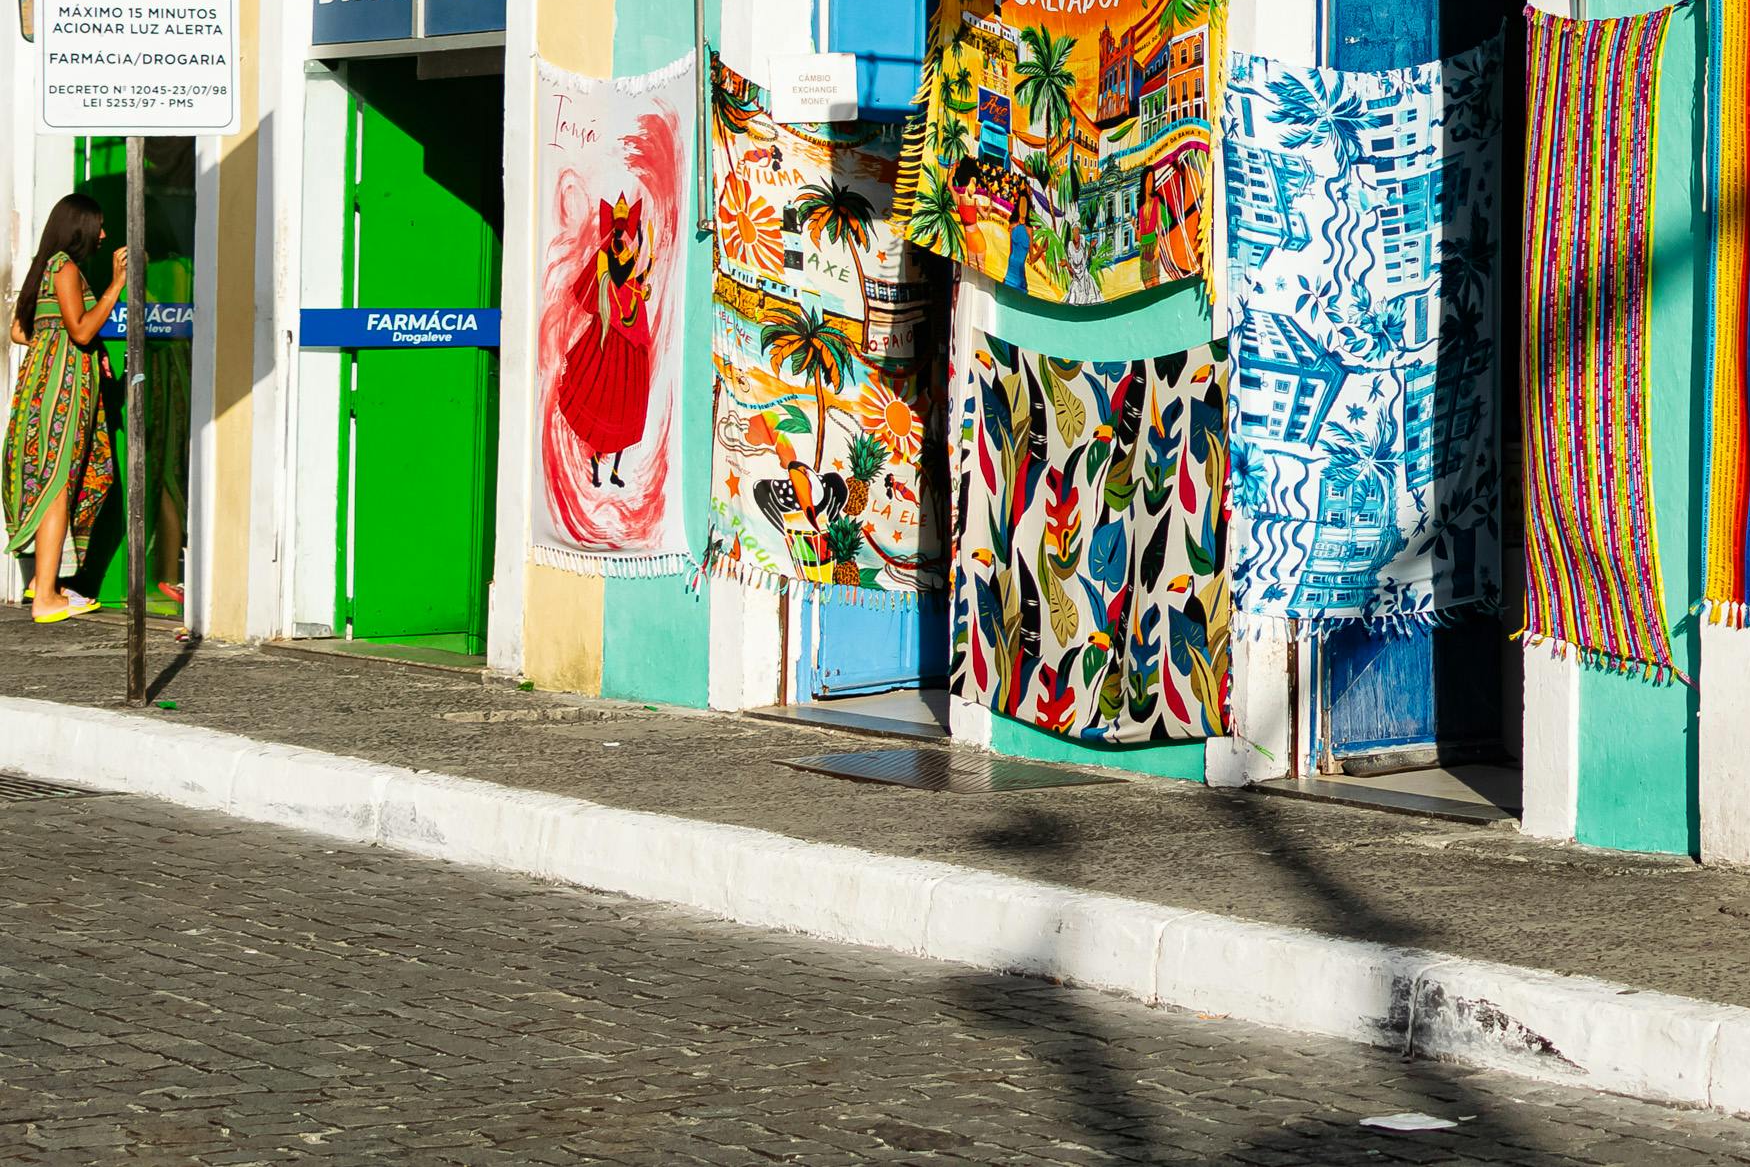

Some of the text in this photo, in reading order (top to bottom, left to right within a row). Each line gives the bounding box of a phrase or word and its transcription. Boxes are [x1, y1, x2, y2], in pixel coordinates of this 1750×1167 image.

[59, 4, 217, 20] MÁXIMO 15 MINUTOS
[52, 23, 223, 36] ACIONAR LUZ ALERTA
[49, 85, 109, 95] DECRETO
[131, 85, 227, 96] 12045-23/07/98
[792, 86, 838, 94] EXCHANGE
[83, 98, 194, 109] LEI 5253/97 PMS
[800, 98, 831, 106] MONEY
[807, 252, 850, 283] AXÉ
[108, 304, 194, 322] ARÁCIA
[367, 310, 478, 331] FARMÁCIA
[392, 332, 453, 345] Drogaleve
